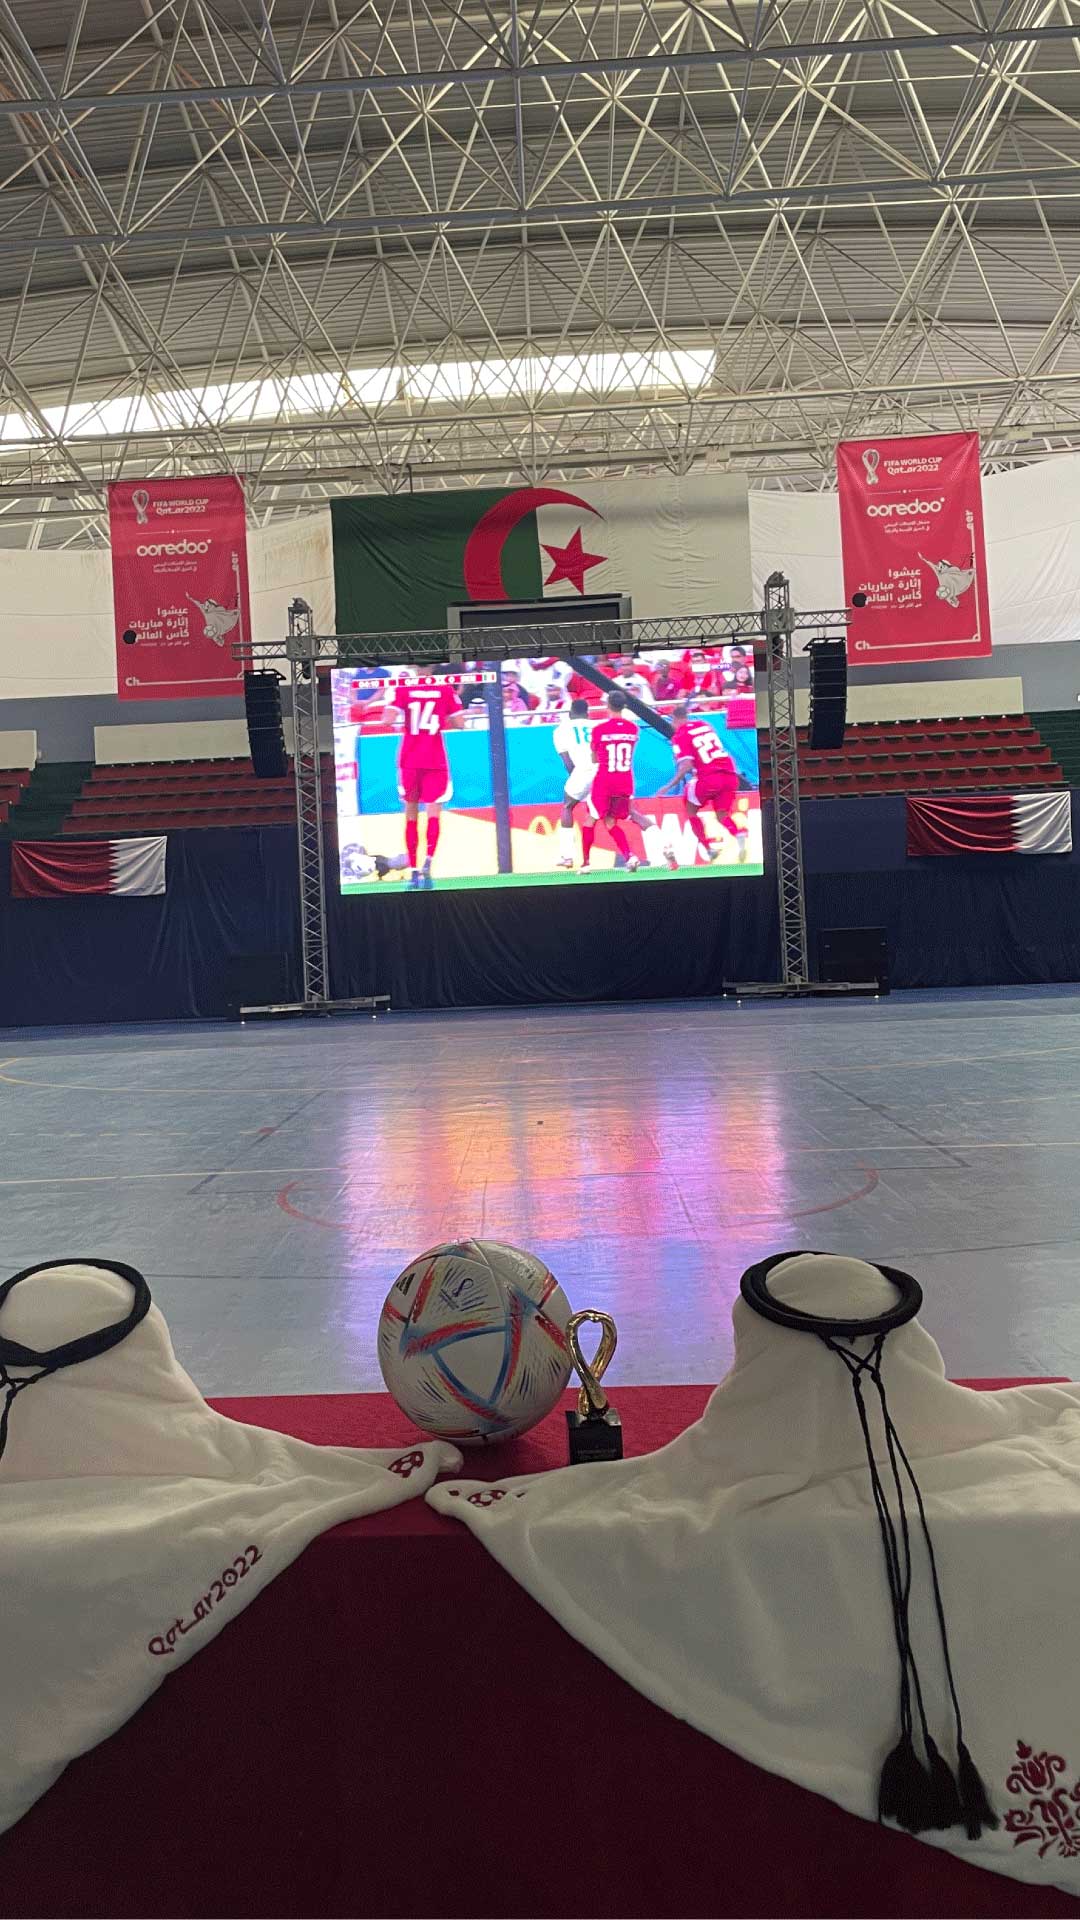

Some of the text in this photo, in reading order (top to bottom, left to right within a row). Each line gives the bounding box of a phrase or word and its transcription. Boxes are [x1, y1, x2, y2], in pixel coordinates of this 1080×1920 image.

[900, 458, 927, 466] WORLD
[928, 456, 943, 464] CUP
[867, 498, 942, 517] ooredoo
[137, 539, 208, 557] ooredoo
[888, 567, 921, 580] عيشوا
[859, 579, 921, 592] إثارة مباريات
[865, 589, 922, 605] كأس العالم
[158, 605, 188, 617] عيشوا
[129, 617, 189, 630] إثارة مباريات
[166, 627, 190, 640] كأس
[407, 701, 440, 736] 14
[692, 732, 729, 764] 23
[606, 743, 632, 773] 10
[148, 1545, 263, 1656] Qatar2022
